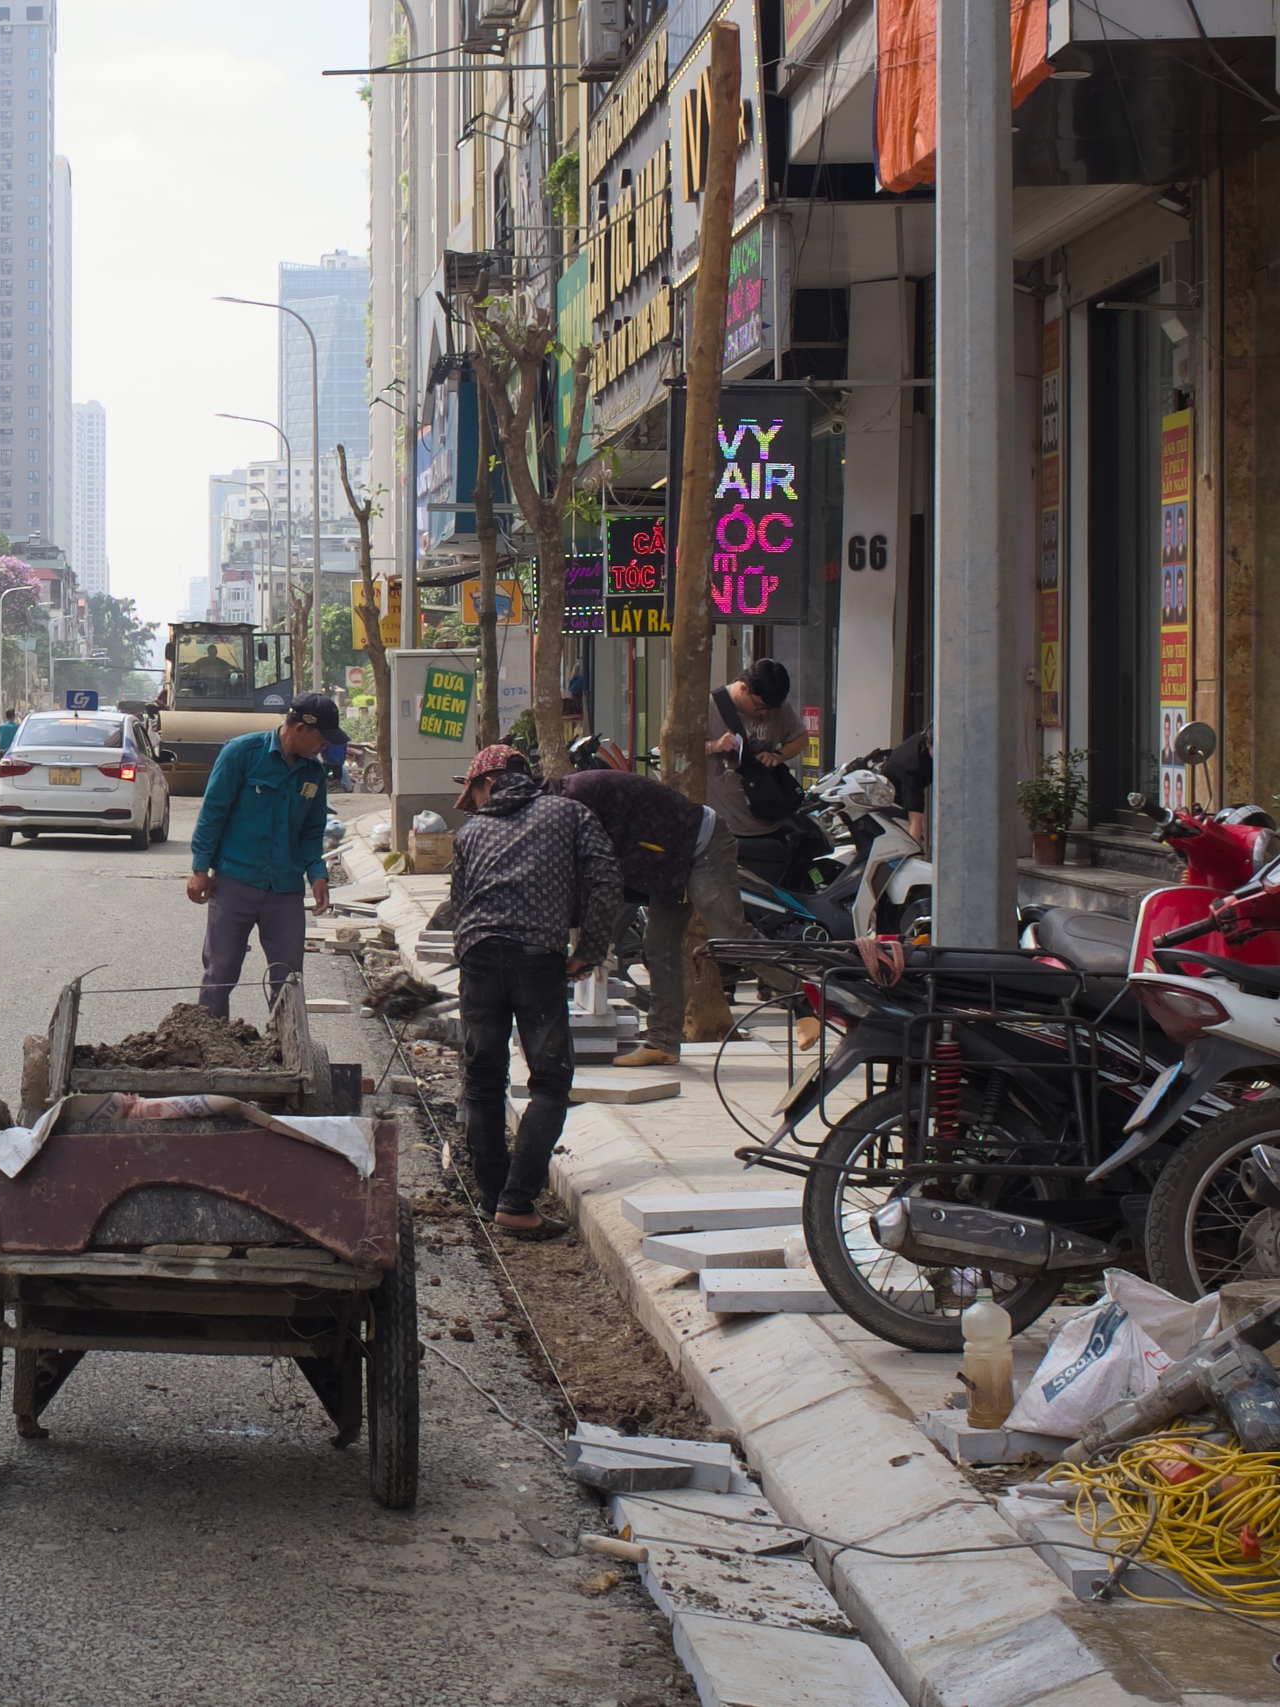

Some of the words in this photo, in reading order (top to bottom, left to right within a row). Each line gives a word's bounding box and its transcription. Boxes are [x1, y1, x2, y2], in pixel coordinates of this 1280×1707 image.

[1164, 462, 1168, 476] 5
[1169, 455, 1184, 475] PHÚT
[848, 534, 888, 572] 66
[611, 559, 656, 590] TÓC
[611, 601, 643, 633] LẤY
[1163, 664, 1166, 678] 5
[1167, 660, 1184, 678] PHÚT
[432, 671, 465, 693] DỪA
[73, 692, 91, 709] G7
[425, 694, 467, 715] XIÊM
[420, 713, 441, 734] BẾN
[444, 720, 464, 738] TRE
